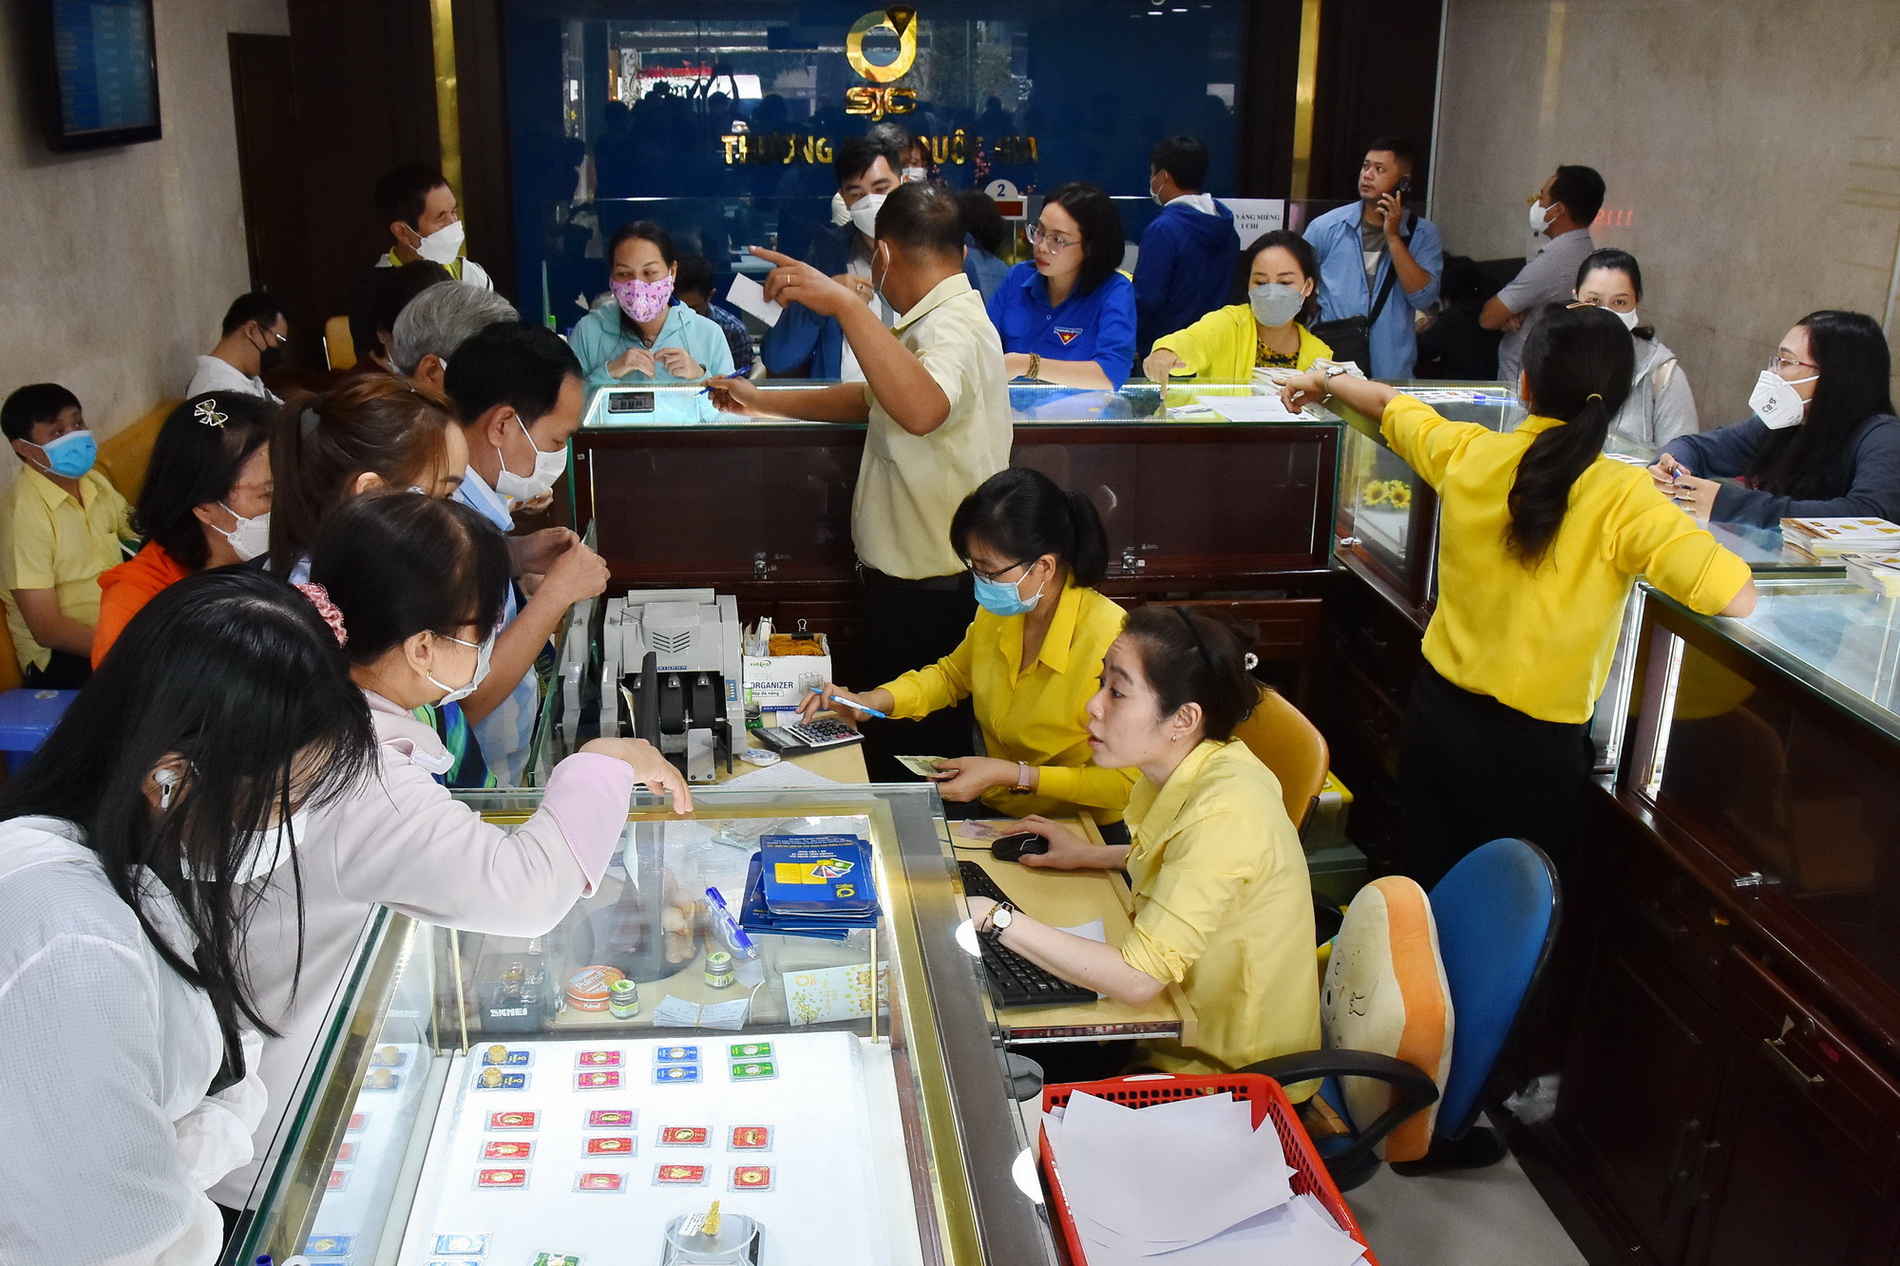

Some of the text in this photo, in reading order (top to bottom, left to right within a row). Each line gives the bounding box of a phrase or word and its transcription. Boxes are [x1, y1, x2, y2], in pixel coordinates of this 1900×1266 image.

[845, 86, 918, 122] SJC
[996, 183, 1006, 197] 2
[749, 672, 773, 681] DESK
[750, 681, 794, 689] ORGANIZER
[489, 1007, 528, 1017] SKMEI
